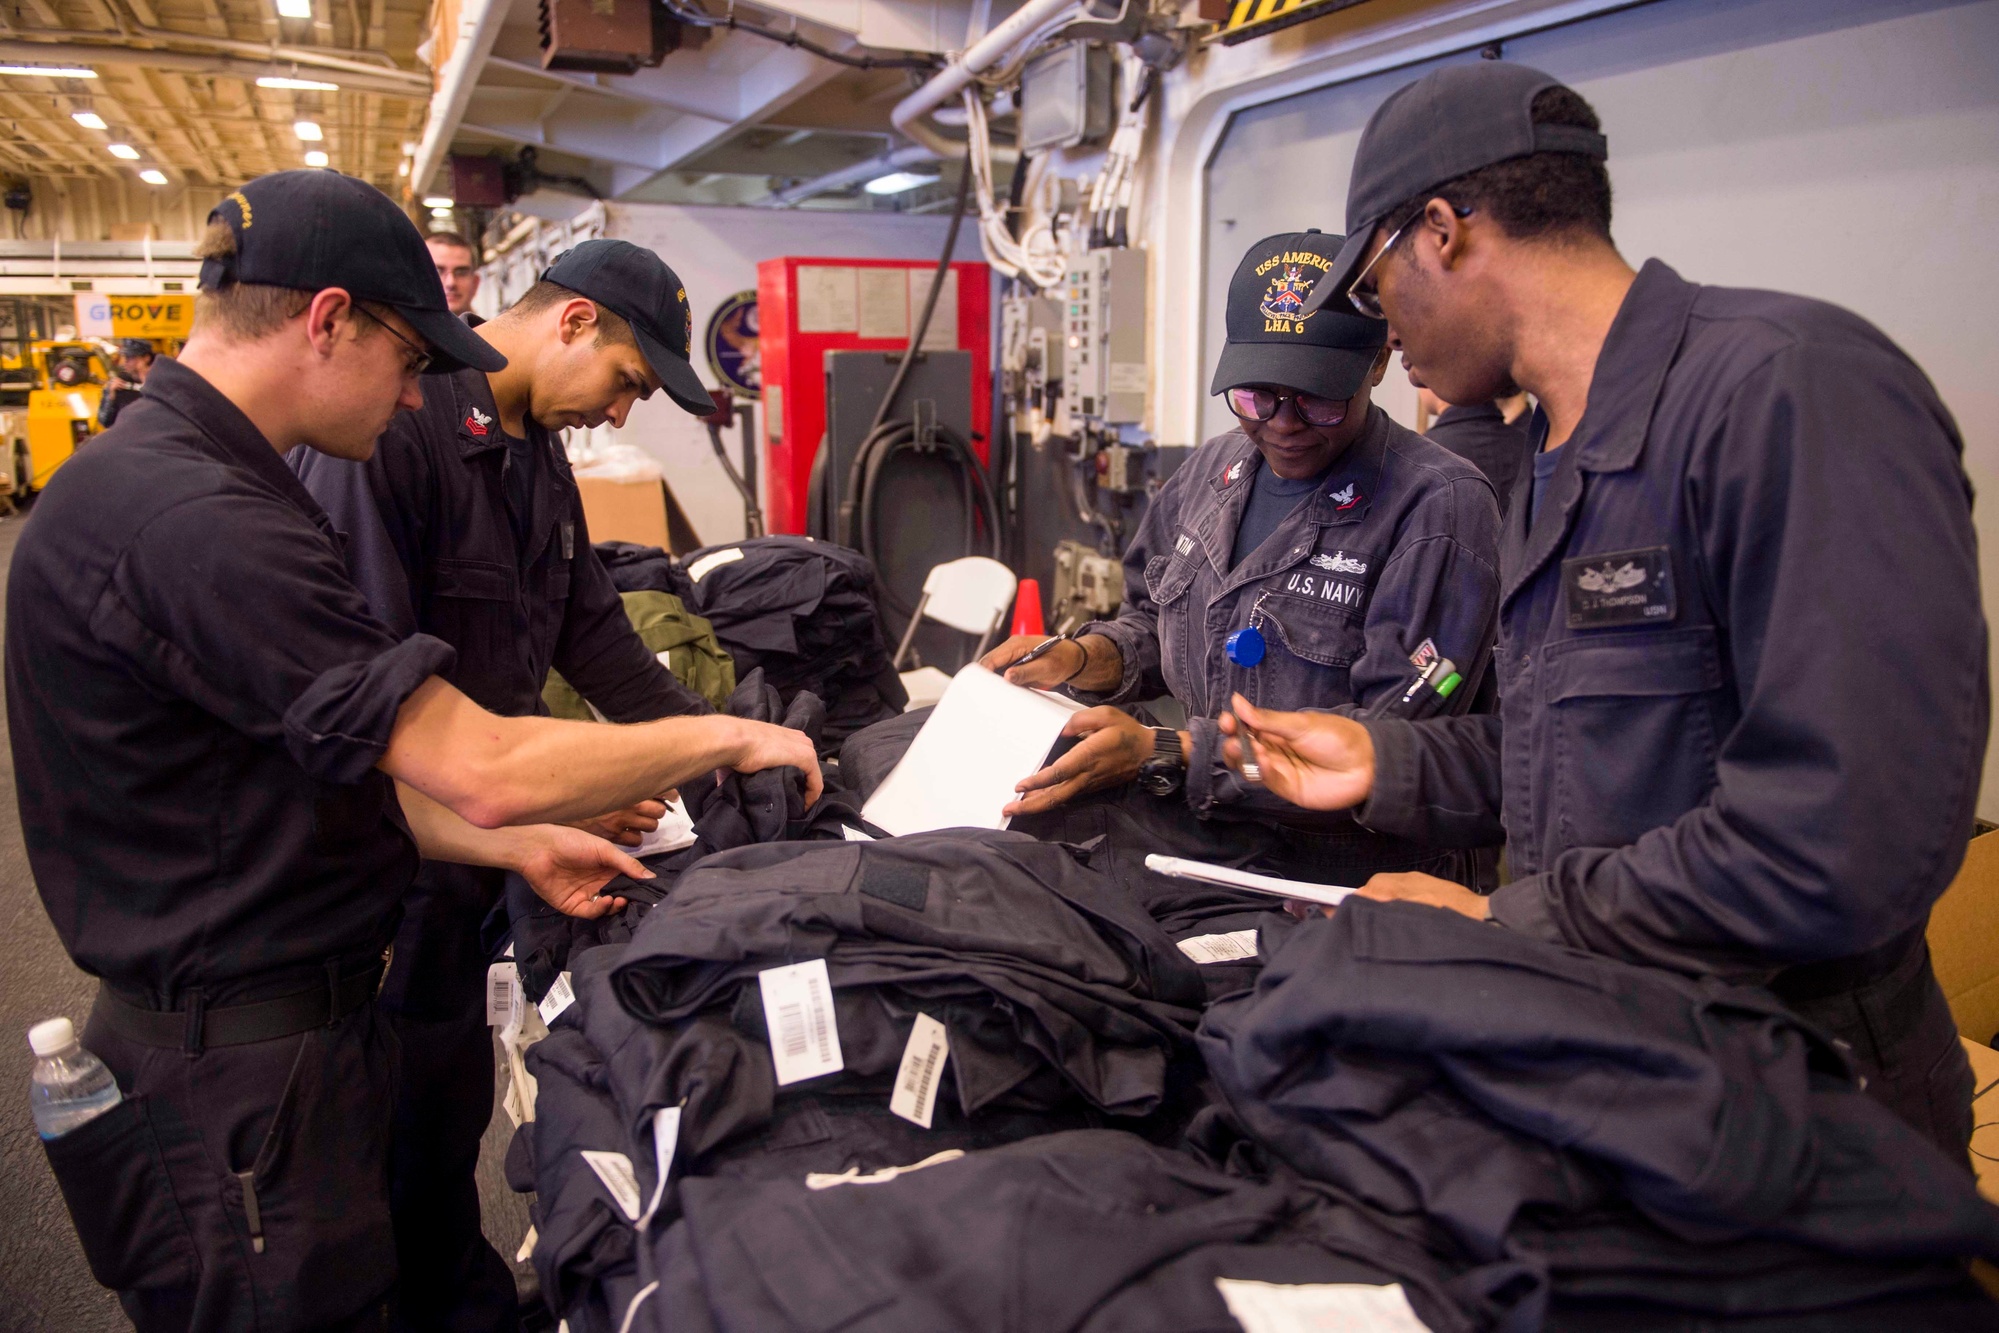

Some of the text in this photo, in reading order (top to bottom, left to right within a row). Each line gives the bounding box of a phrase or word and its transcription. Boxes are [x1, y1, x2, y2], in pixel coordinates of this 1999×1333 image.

[1255, 251, 1333, 276] USS AMERIC
[90, 304, 182, 321] GROVE
[1265, 320, 1304, 334] LHA 6
[1287, 573, 1364, 608] U.S. NAVY
